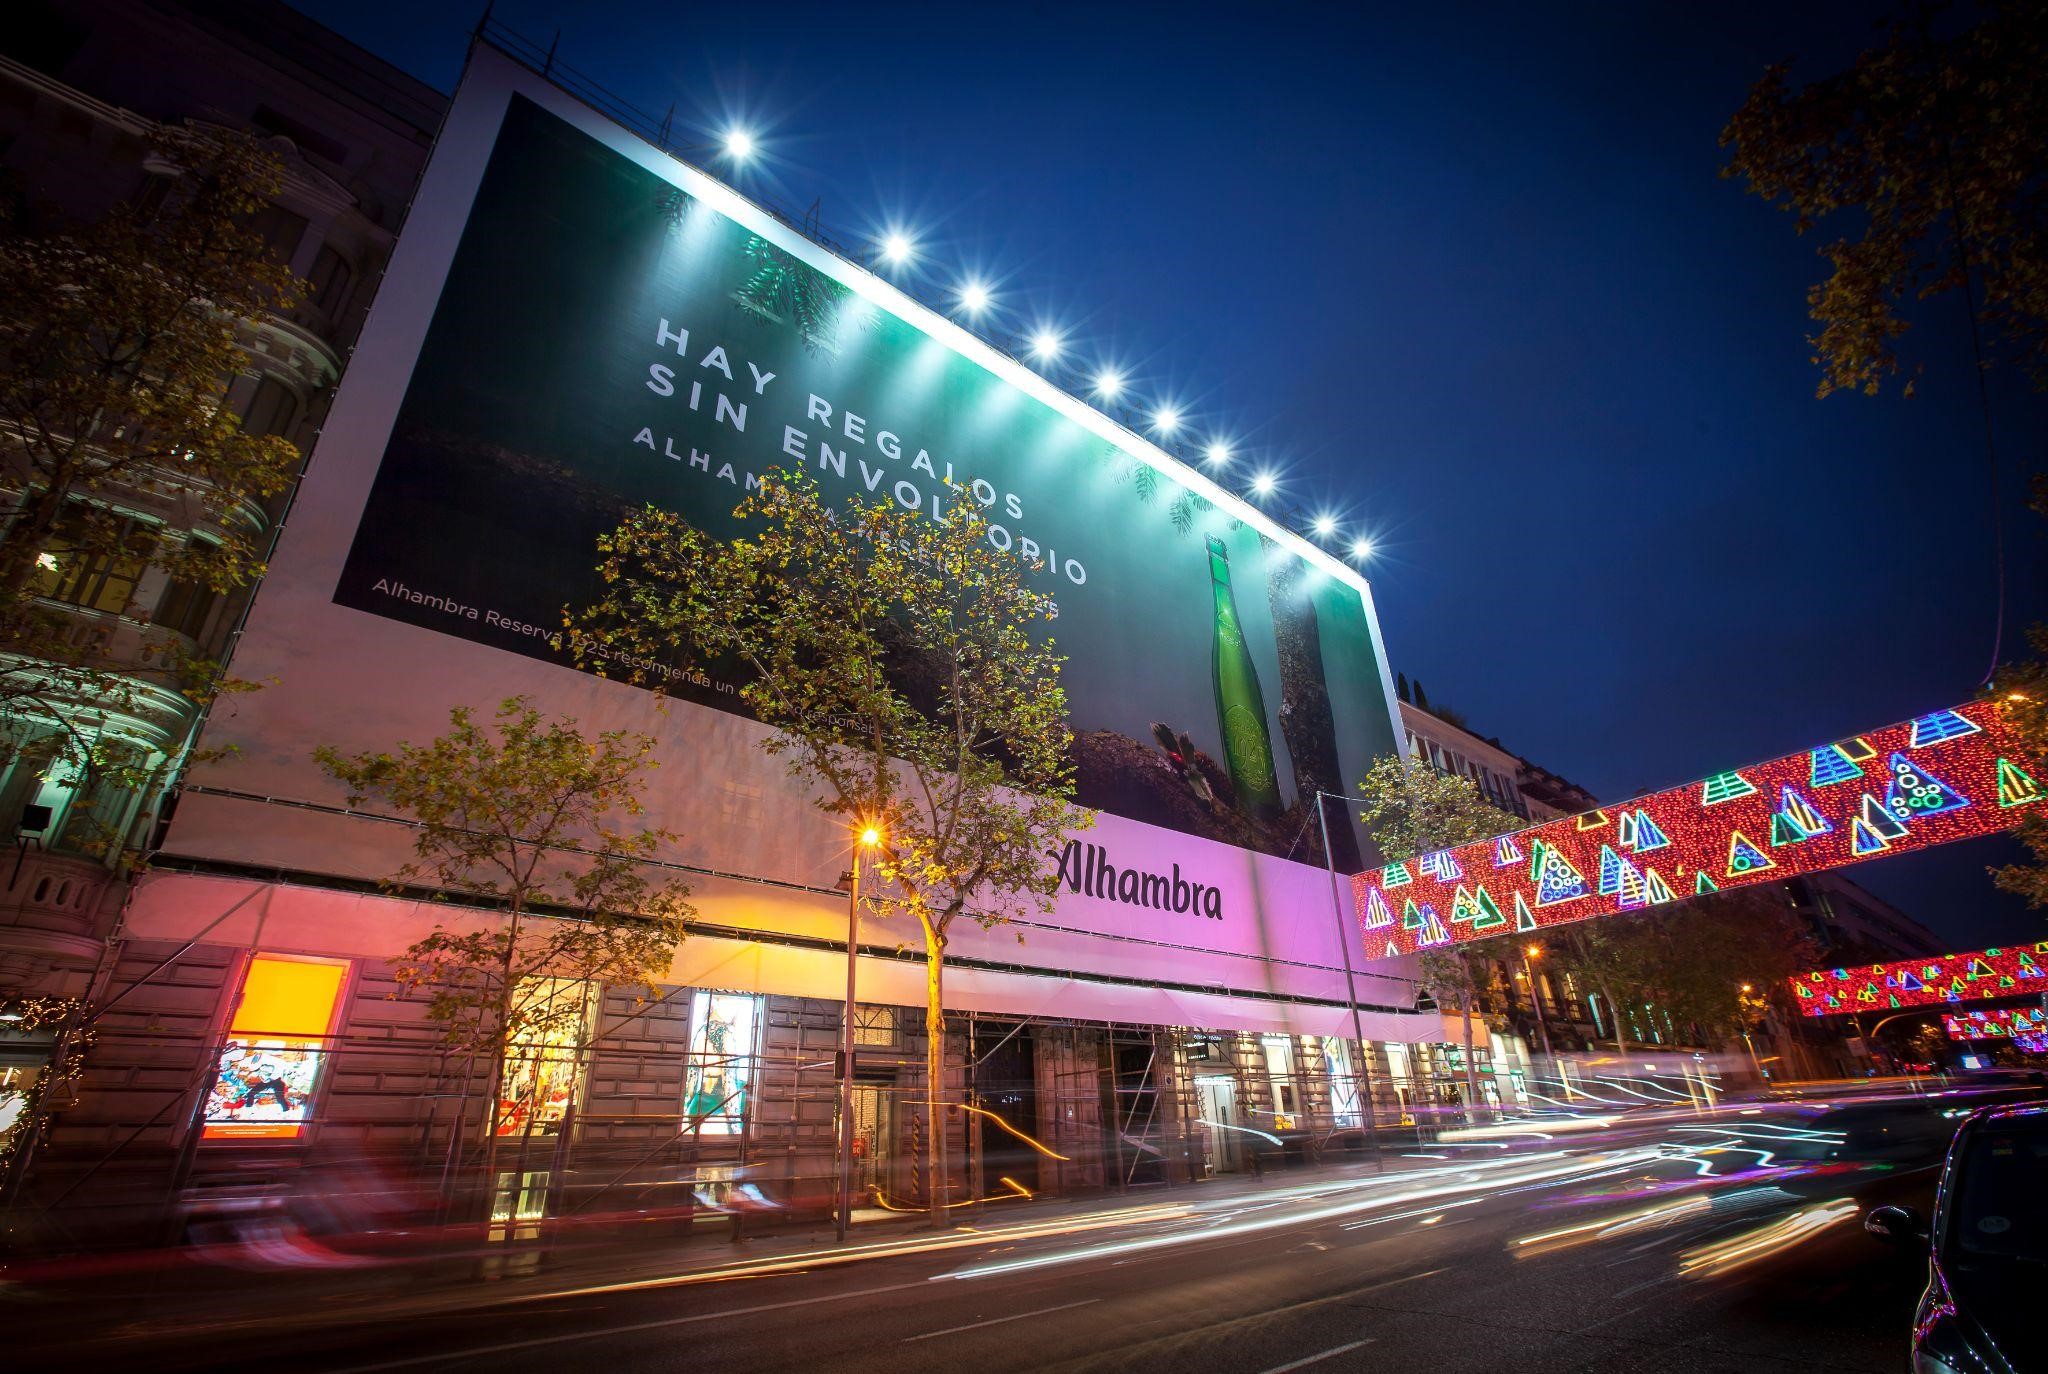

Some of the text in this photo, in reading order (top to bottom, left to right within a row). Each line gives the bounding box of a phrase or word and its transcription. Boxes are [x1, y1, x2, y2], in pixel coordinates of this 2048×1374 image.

[645, 363, 748, 432] SIN
[656, 317, 1023, 520] HAY REGALOS
[372, 578, 478, 620] Alhambra
[485, 610, 563, 644] Reserva
[716, 680, 734, 695] un
[1045, 839, 1223, 920] Alhambra
